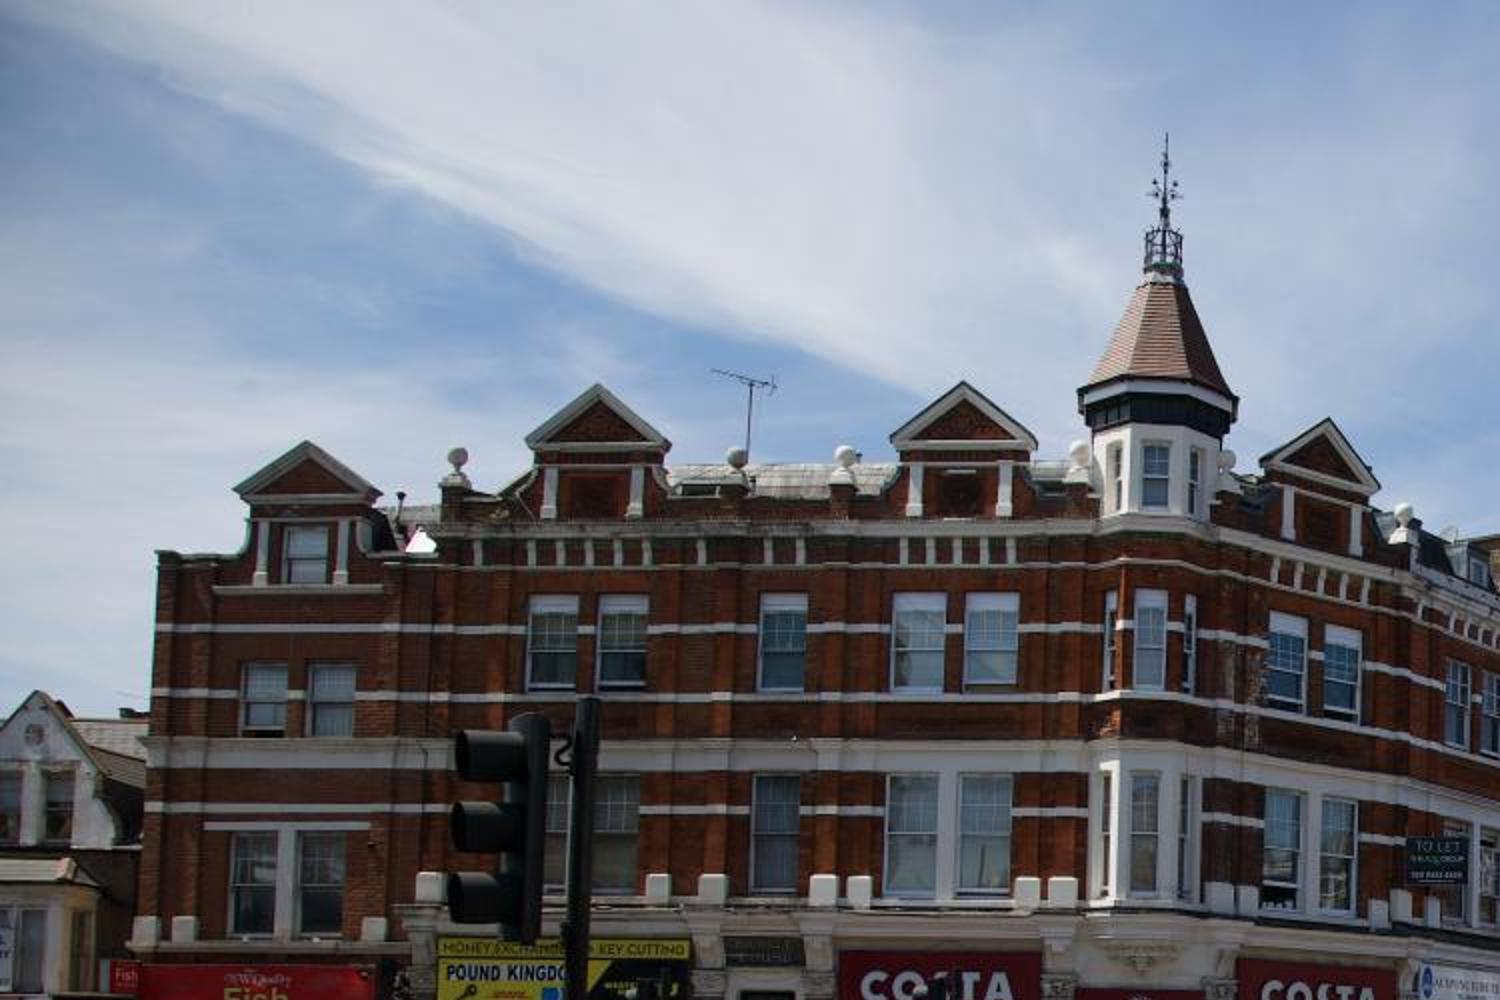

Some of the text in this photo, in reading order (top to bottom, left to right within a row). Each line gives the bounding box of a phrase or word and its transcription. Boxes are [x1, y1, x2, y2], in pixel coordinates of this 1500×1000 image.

[599, 944, 685, 957] KEY CUTTING
[447, 964, 568, 981] POUND KINGDO
